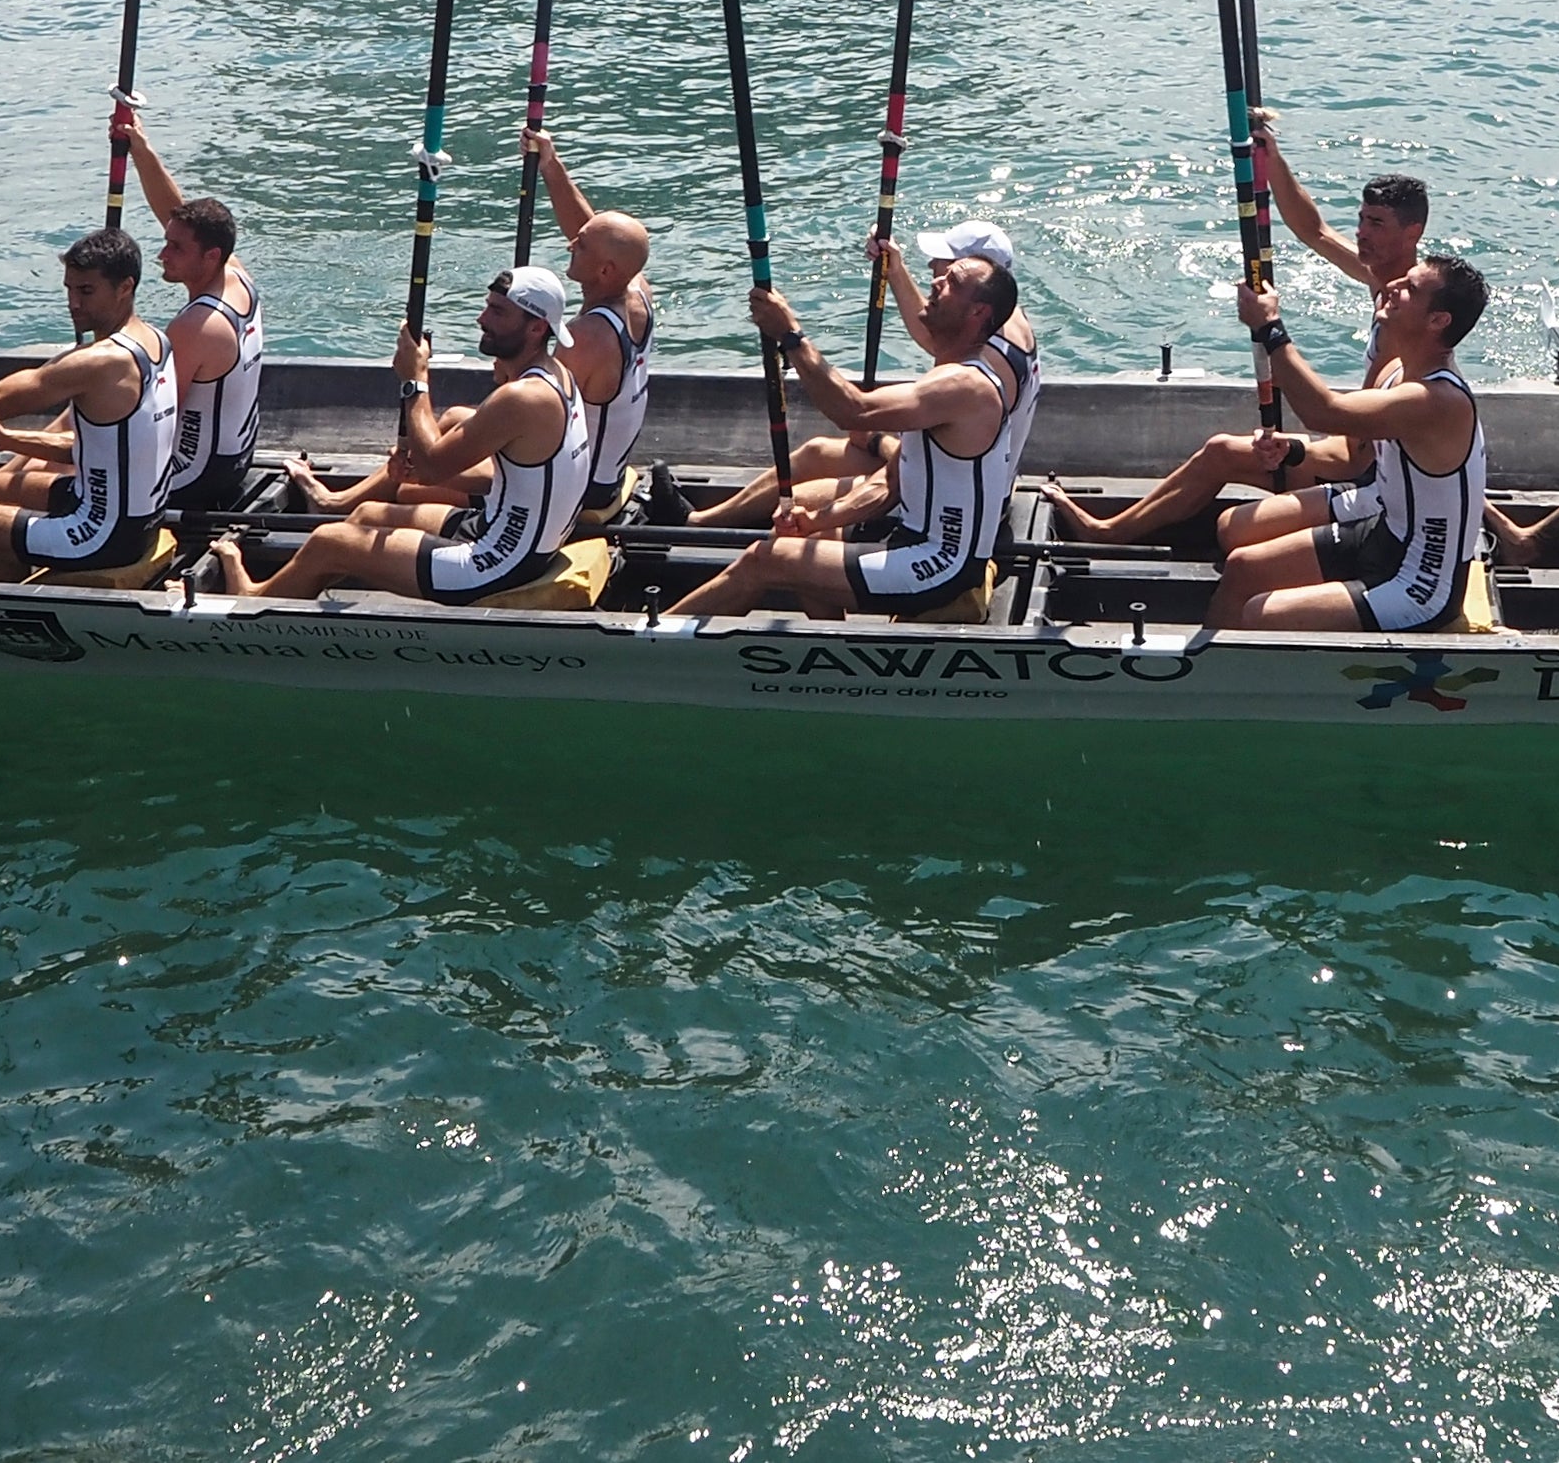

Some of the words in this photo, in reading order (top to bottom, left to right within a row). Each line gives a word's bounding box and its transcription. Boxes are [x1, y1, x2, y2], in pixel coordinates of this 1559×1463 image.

[493, 505, 530, 558] PEDREÑA
[937, 506, 964, 564] PEDREÑA
[1419, 517, 1448, 580] PEDREÑA
[82, 629, 305, 659] Marina
[321, 643, 378, 661] de
[393, 645, 587, 672] Cudeyo
[207, 621, 391, 640] AYUNTAMIENTO
[398, 629, 430, 641] DE
[738, 644, 1194, 683] SAWATCO
[751, 682, 780, 693] La
[896, 687, 937, 698] del
[945, 687, 1009, 699] dato
